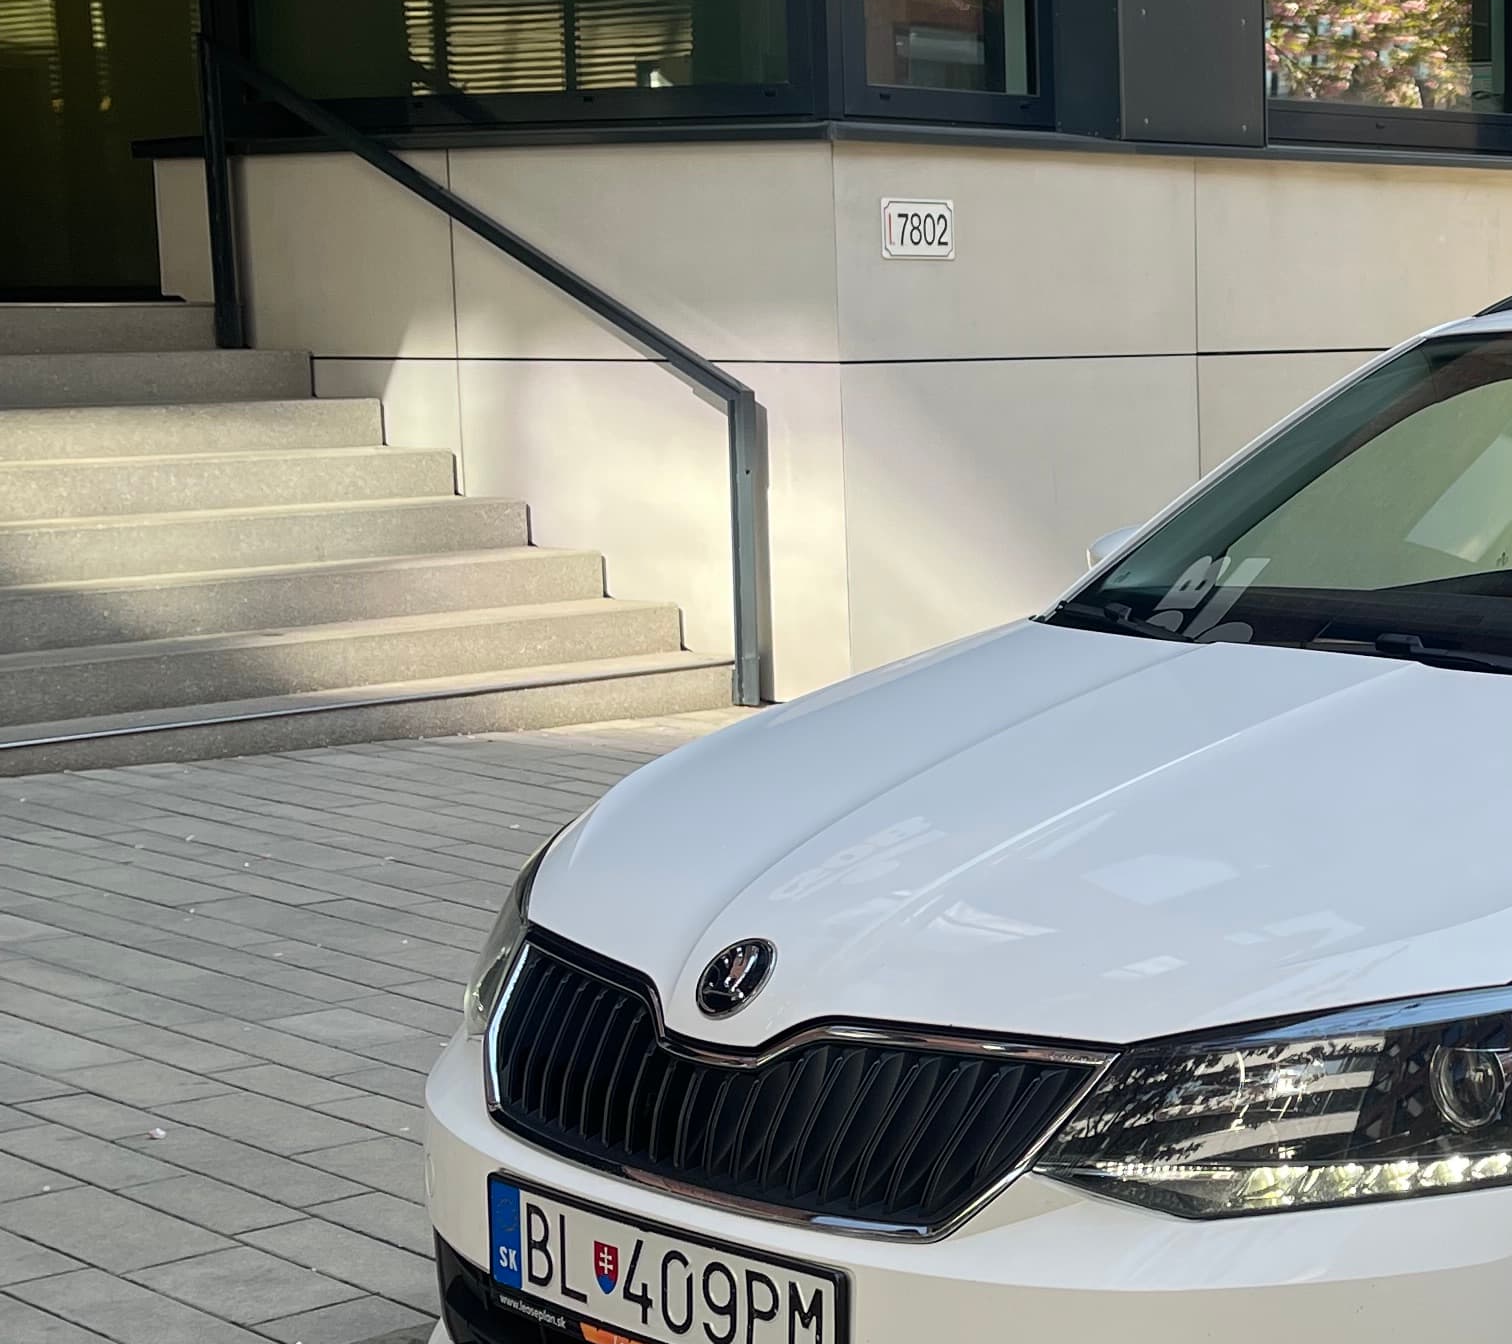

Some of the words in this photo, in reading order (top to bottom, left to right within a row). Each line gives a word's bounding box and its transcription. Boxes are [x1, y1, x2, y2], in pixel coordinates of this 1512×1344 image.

[897, 212, 949, 246] 7802
[499, 1245, 518, 1273] SK
[526, 1202, 588, 1304] BL
[499, 1294, 566, 1330] www.leaseplan.sk
